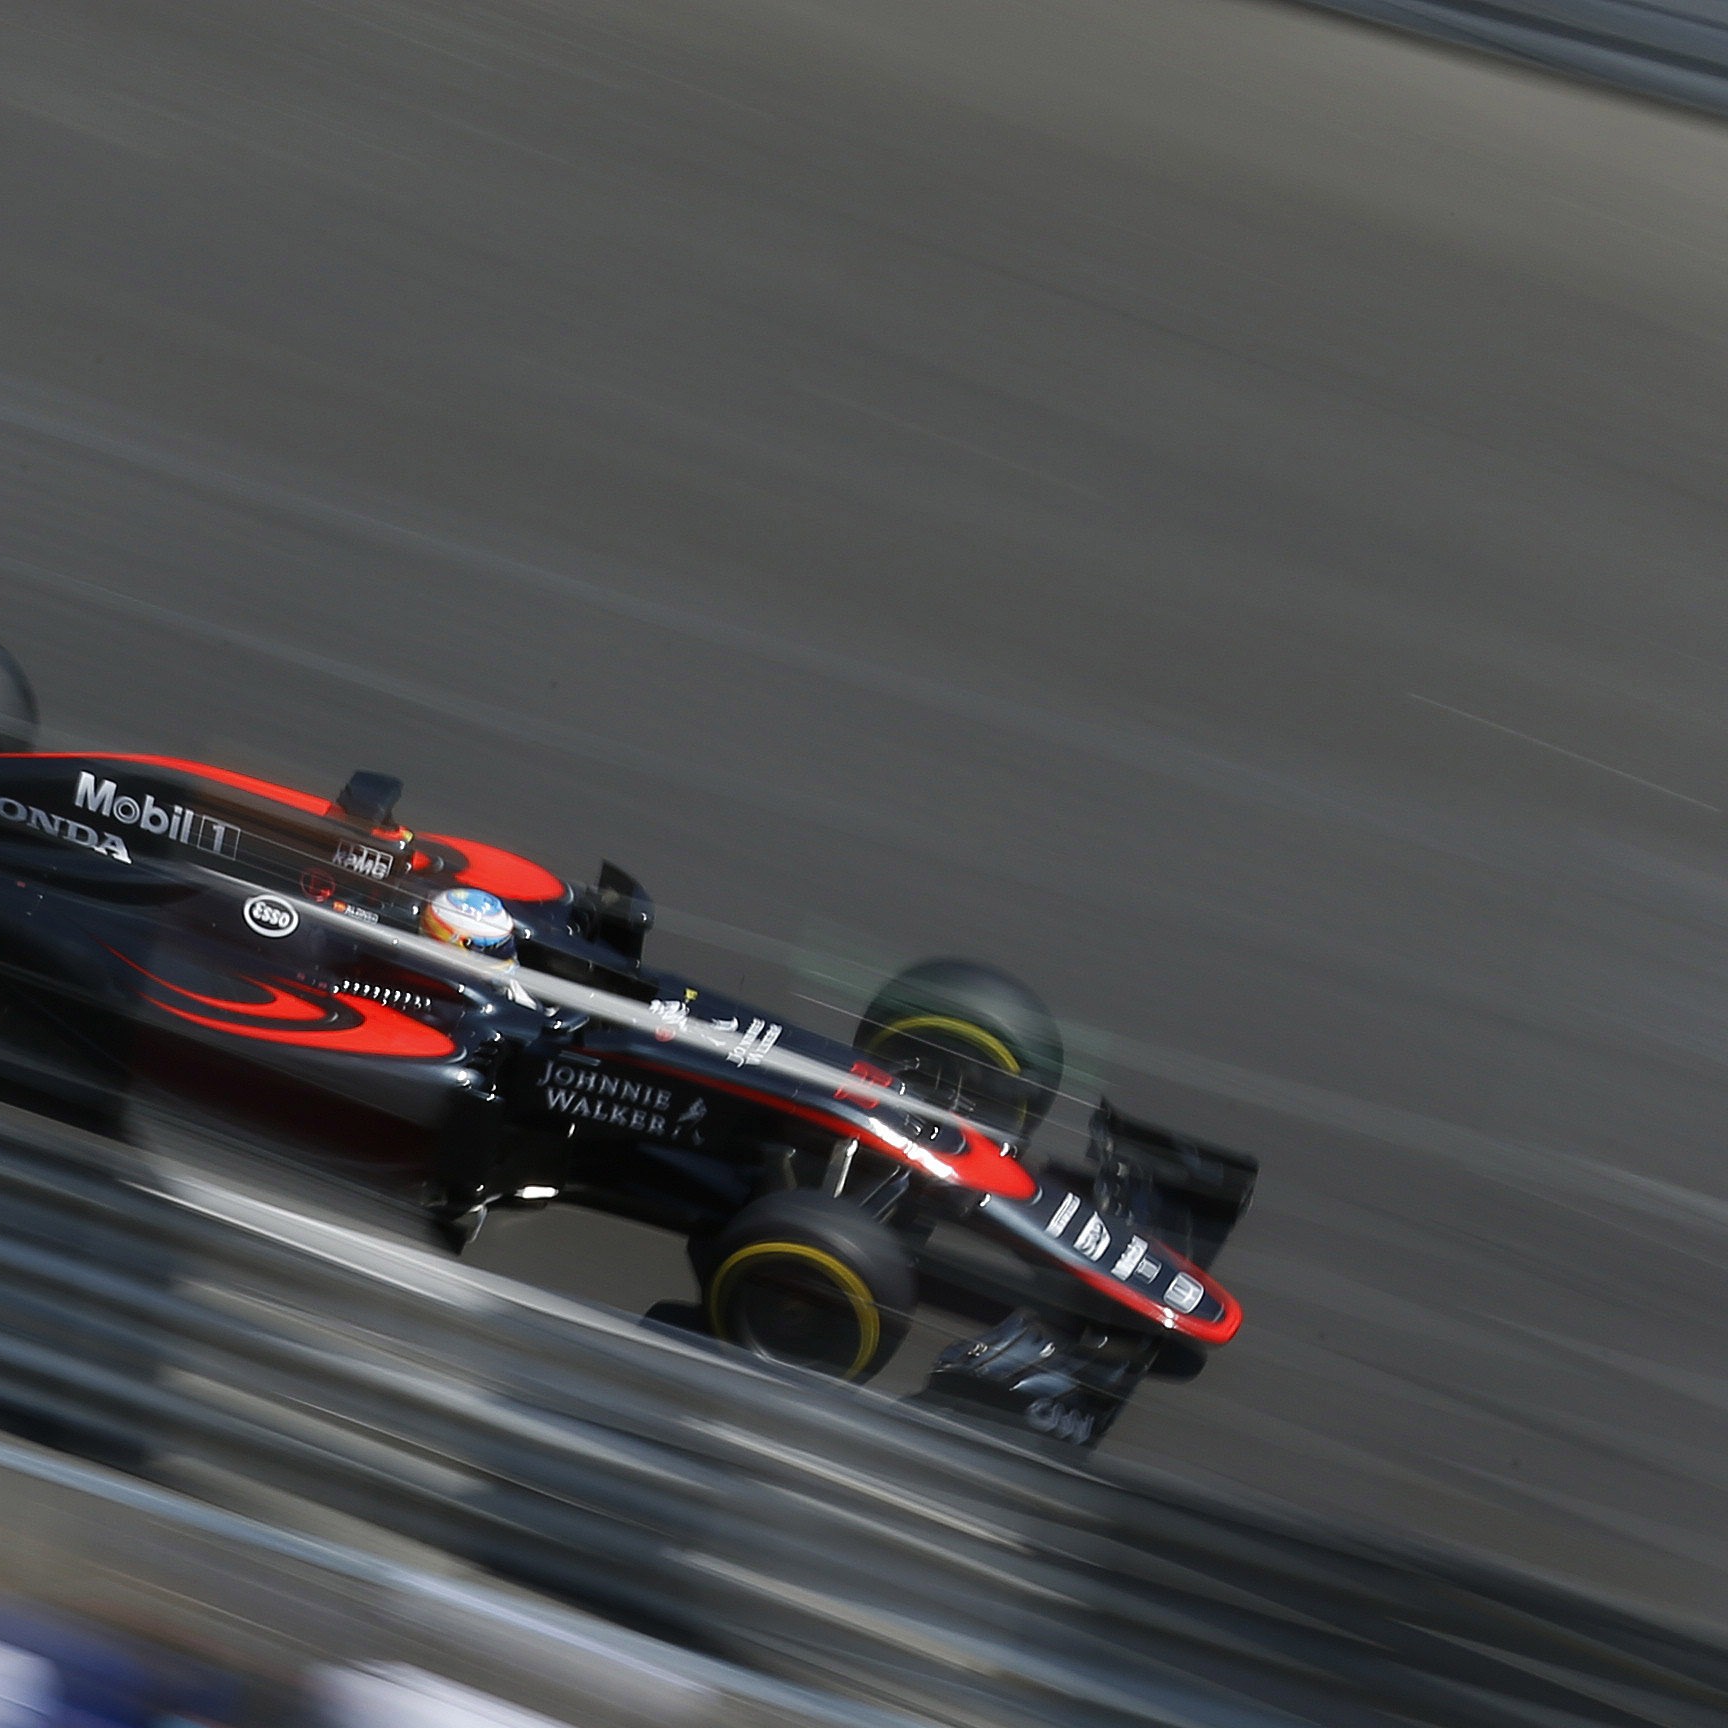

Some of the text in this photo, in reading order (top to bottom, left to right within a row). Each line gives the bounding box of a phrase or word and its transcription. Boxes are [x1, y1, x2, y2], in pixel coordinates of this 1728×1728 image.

[75, 770, 194, 844] Mobil
[537, 1060, 672, 1111] JOHNNIE
[546, 1086, 667, 1137] WALKER
